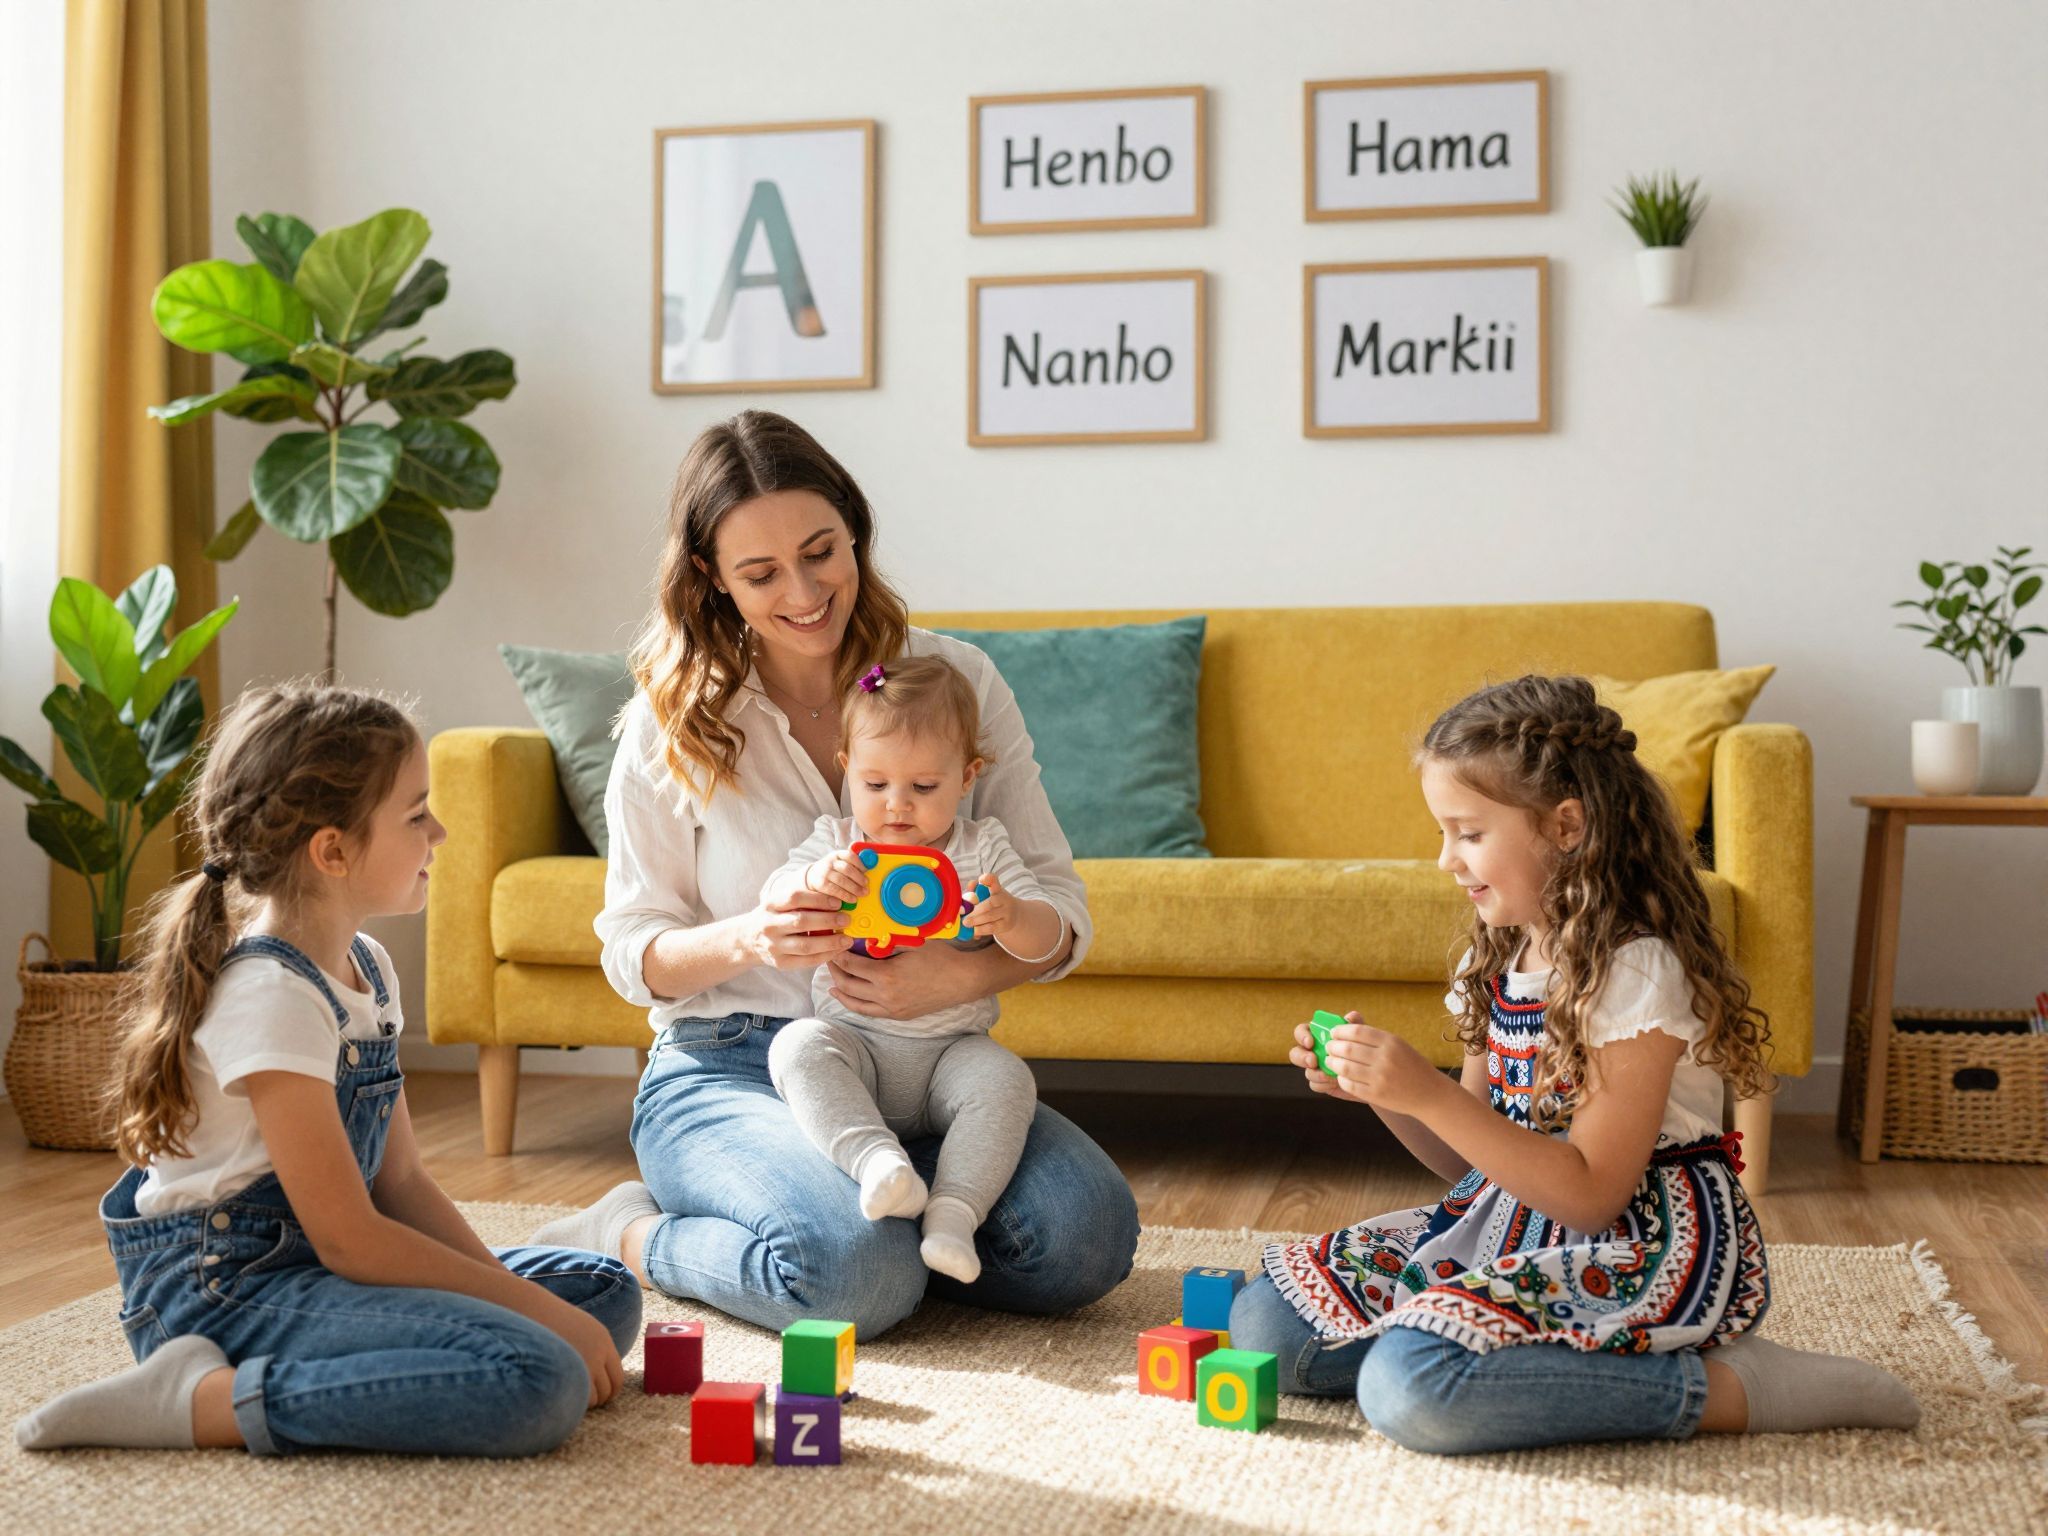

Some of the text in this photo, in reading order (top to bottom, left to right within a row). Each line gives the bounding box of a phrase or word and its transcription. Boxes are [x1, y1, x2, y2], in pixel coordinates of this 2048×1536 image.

[1347, 119, 1511, 177] Hama
[702, 179, 828, 343] A
[1002, 322, 1174, 388] Nanho
[791, 1413, 820, 1457] Z
